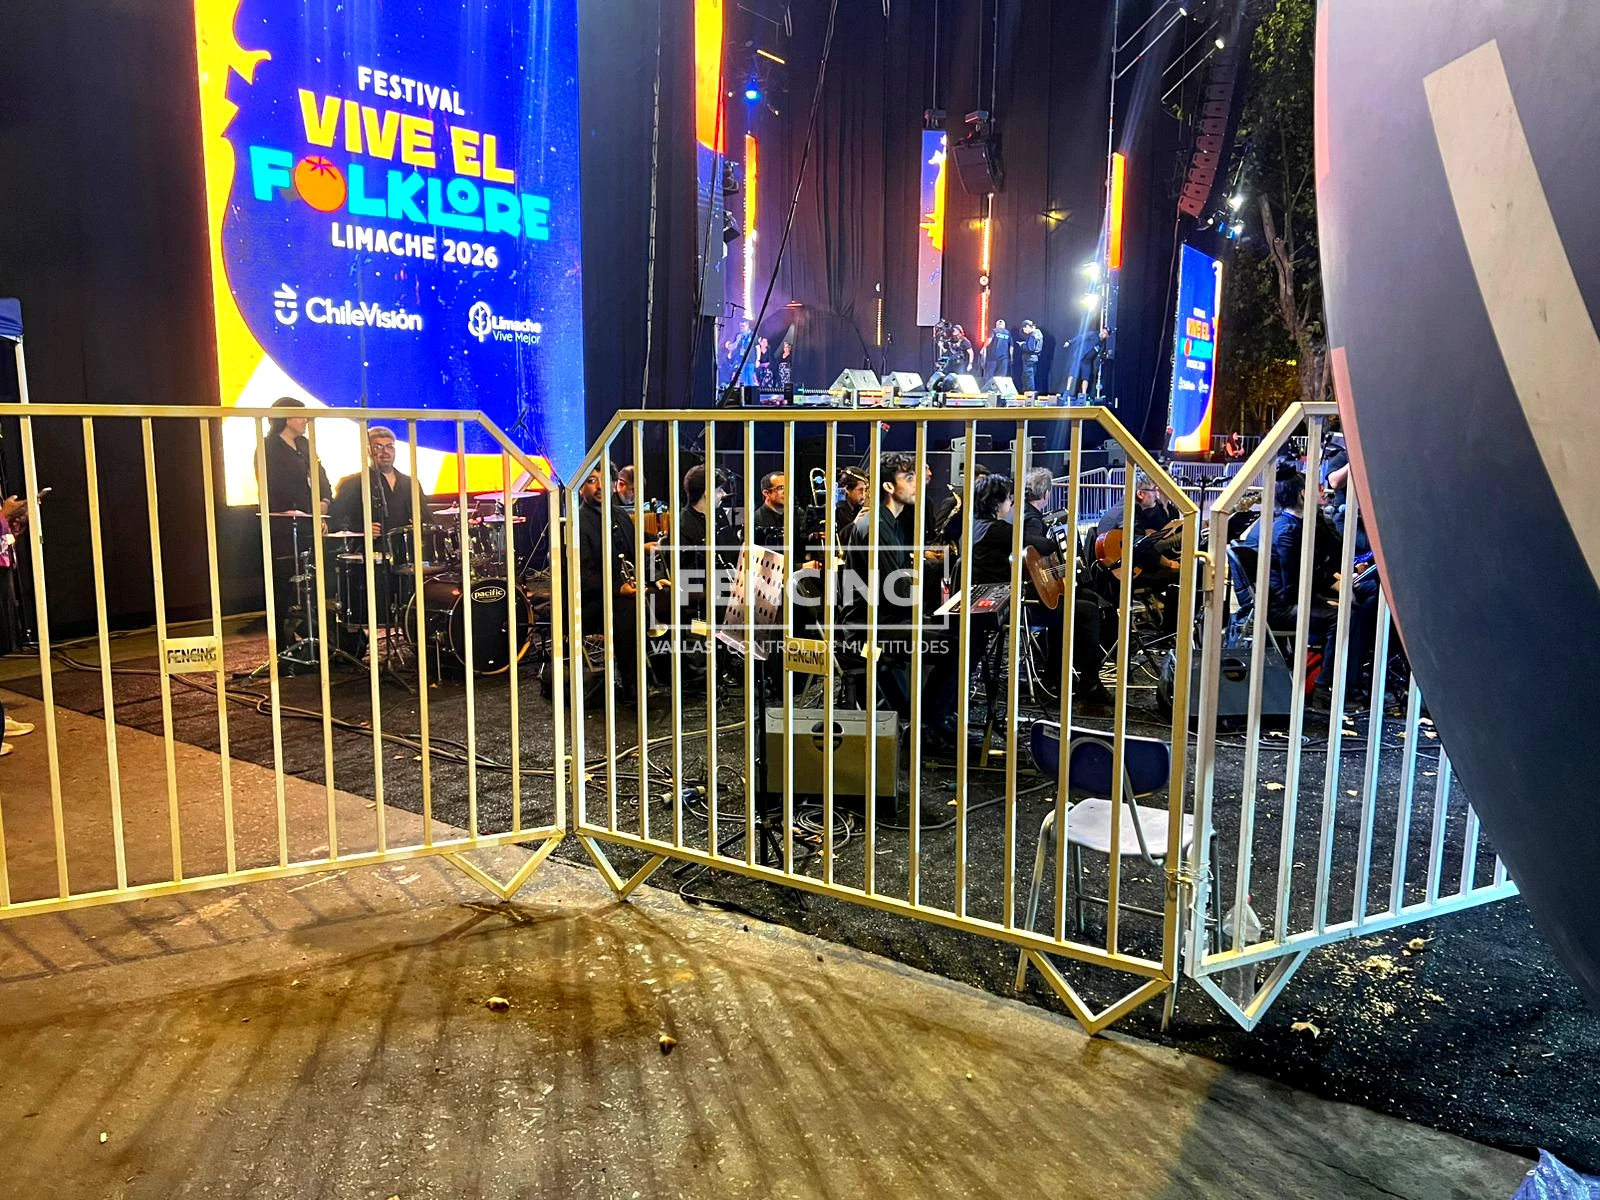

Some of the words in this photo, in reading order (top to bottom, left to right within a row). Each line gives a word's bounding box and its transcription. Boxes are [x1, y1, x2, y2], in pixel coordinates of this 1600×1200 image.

[357, 66, 465, 116] FESTIVAL
[298, 88, 436, 169] VIVE
[450, 126, 515, 184] EL
[249, 145, 551, 241] FOLKLORE
[331, 222, 436, 260] LIMACHE
[443, 239, 498, 269] 2026
[305, 296, 423, 331] ChileVisión
[492, 314, 542, 333] Limache
[492, 331, 513, 342] Vive
[515, 333, 541, 345] Mejor
[474, 589, 503, 599] pacific
[167, 647, 217, 664] FENCING
